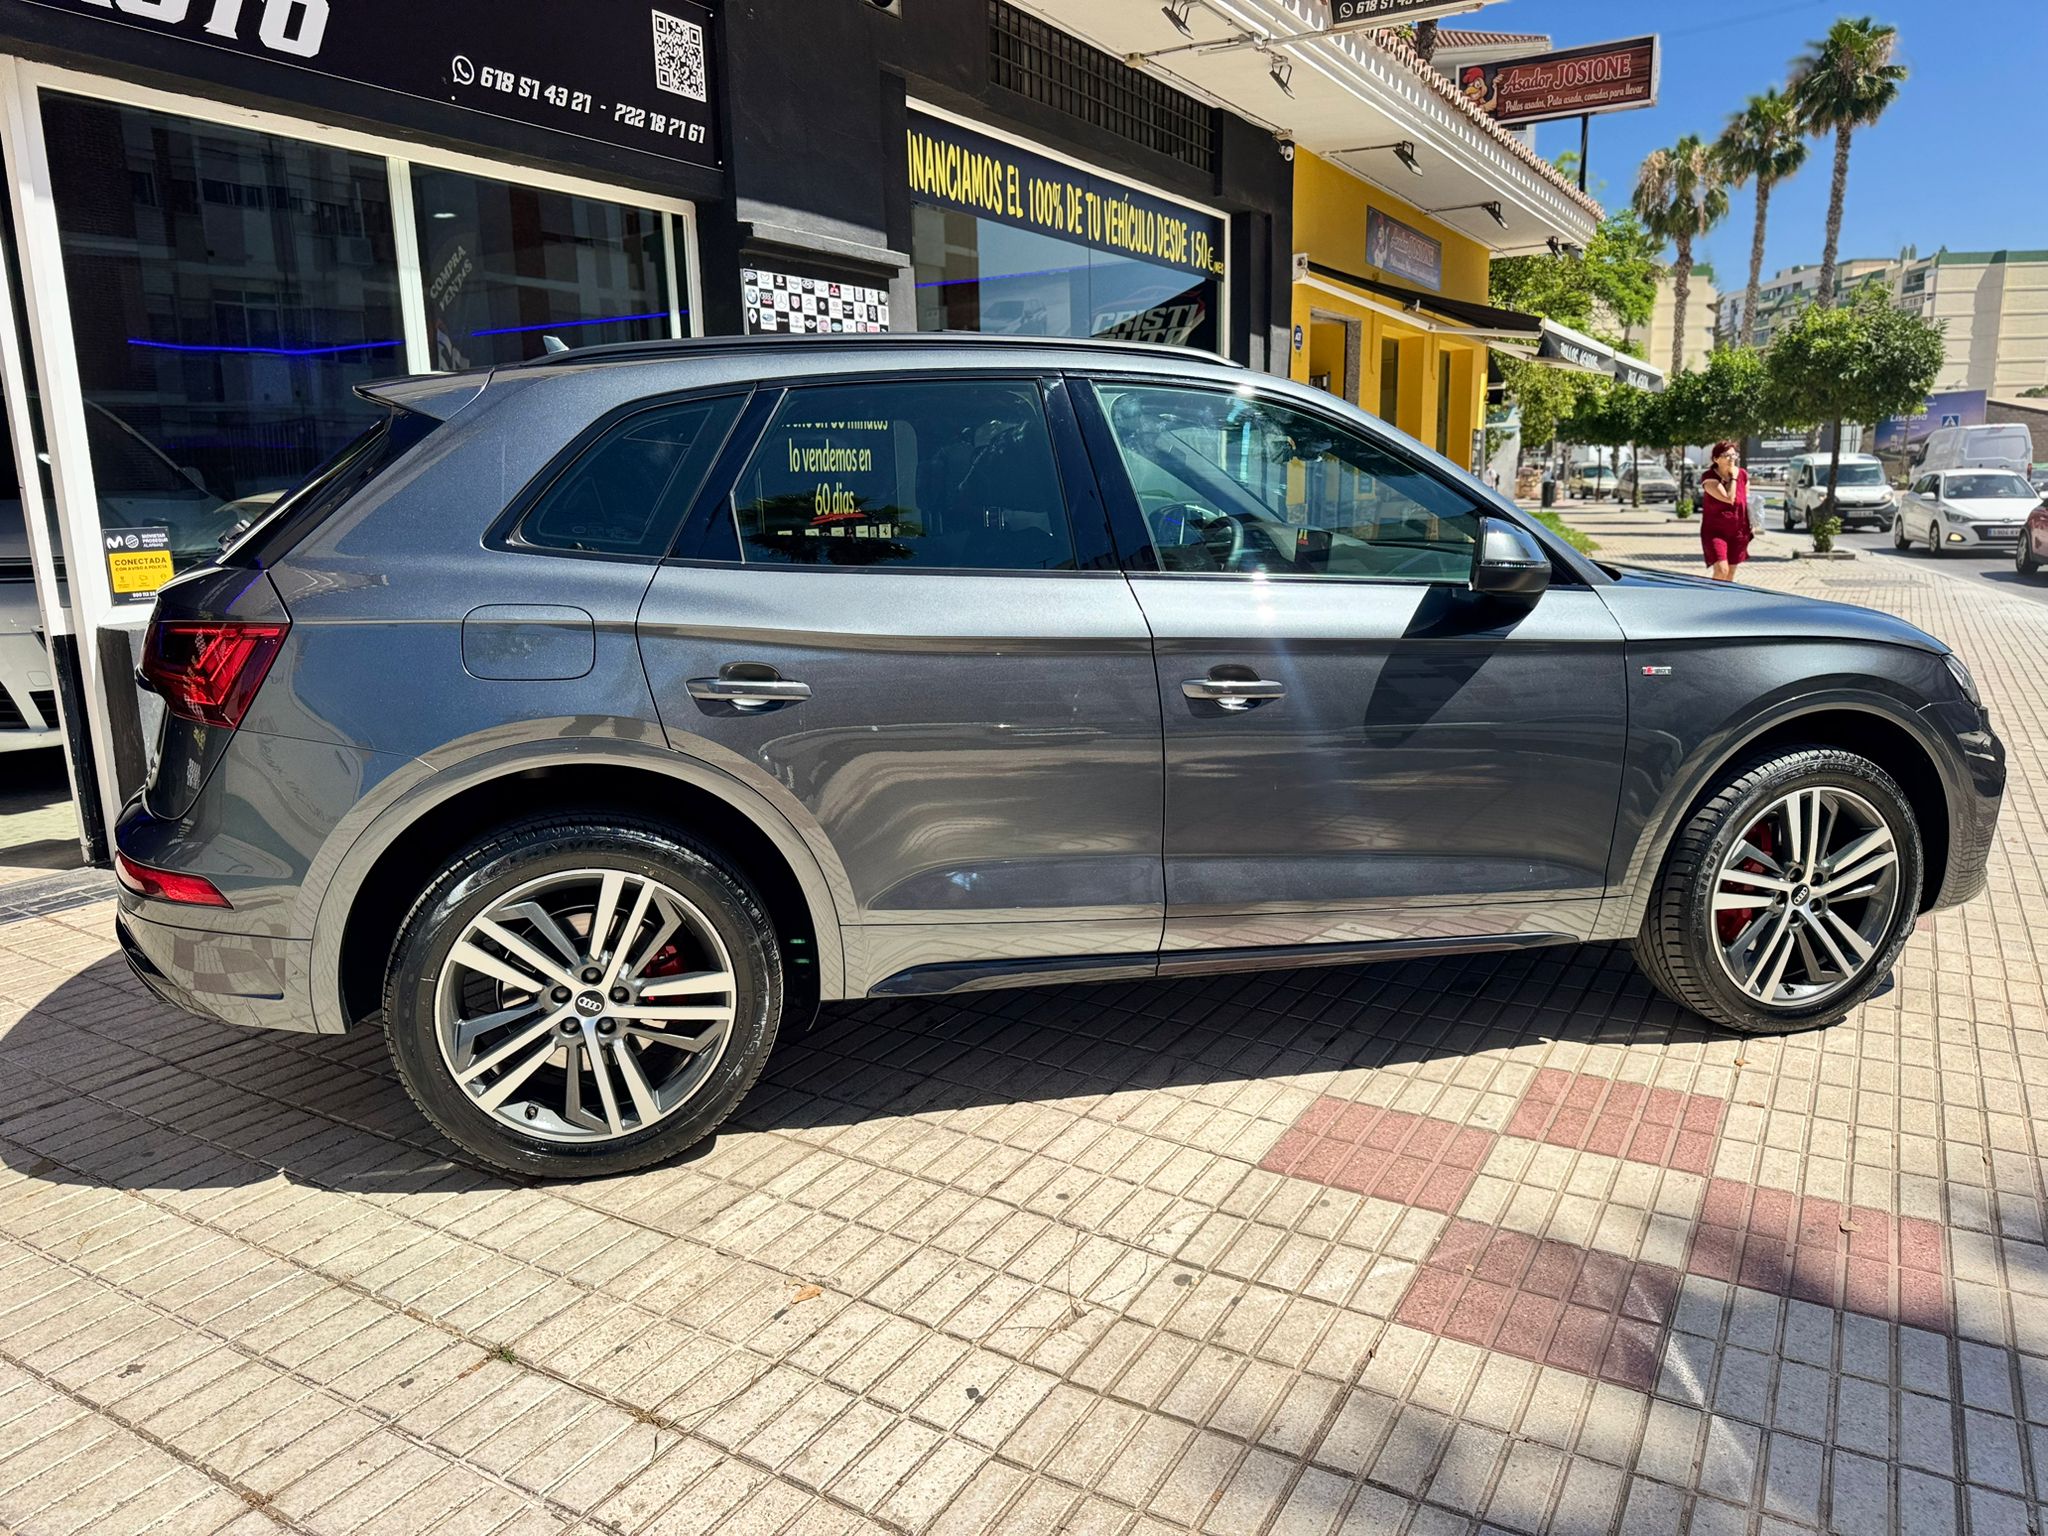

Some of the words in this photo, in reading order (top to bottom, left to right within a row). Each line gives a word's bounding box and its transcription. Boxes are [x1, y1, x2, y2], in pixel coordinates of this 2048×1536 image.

[1501, 69, 1553, 95] Asador
[1553, 53, 1631, 90] JOSIONE
[480, 66, 514, 93] 618
[518, 77, 540, 100] 51
[544, 87, 568, 108] 43
[571, 92, 592, 114] 21
[613, 103, 646, 128] 722
[650, 112, 666, 134] 18
[668, 118, 685, 139] 71
[689, 125, 705, 144] 61
[1505, 100, 1523, 113] Pollos
[1547, 94, 1562, 107] Pata
[1584, 88, 1609, 102] comidas
[1609, 88, 1624, 101] para
[1625, 83, 1644, 96] llevar
[1006, 164, 1024, 218] EL
[1028, 177, 1064, 230] 100%
[1066, 183, 1083, 234] DE
[1085, 192, 1101, 241] TU
[1103, 193, 1155, 256] VEHÍCULO
[1156, 213, 1188, 263] DESDE
[430, 245, 467, 299] COMPRA
[1091, 302, 1204, 336] CRISTI
[788, 437, 800, 472] lo
[802, 438, 858, 472] vendemos
[859, 447, 872, 472] en
[815, 482, 831, 515] 60
[114, 557, 167, 566] CONECTADA
